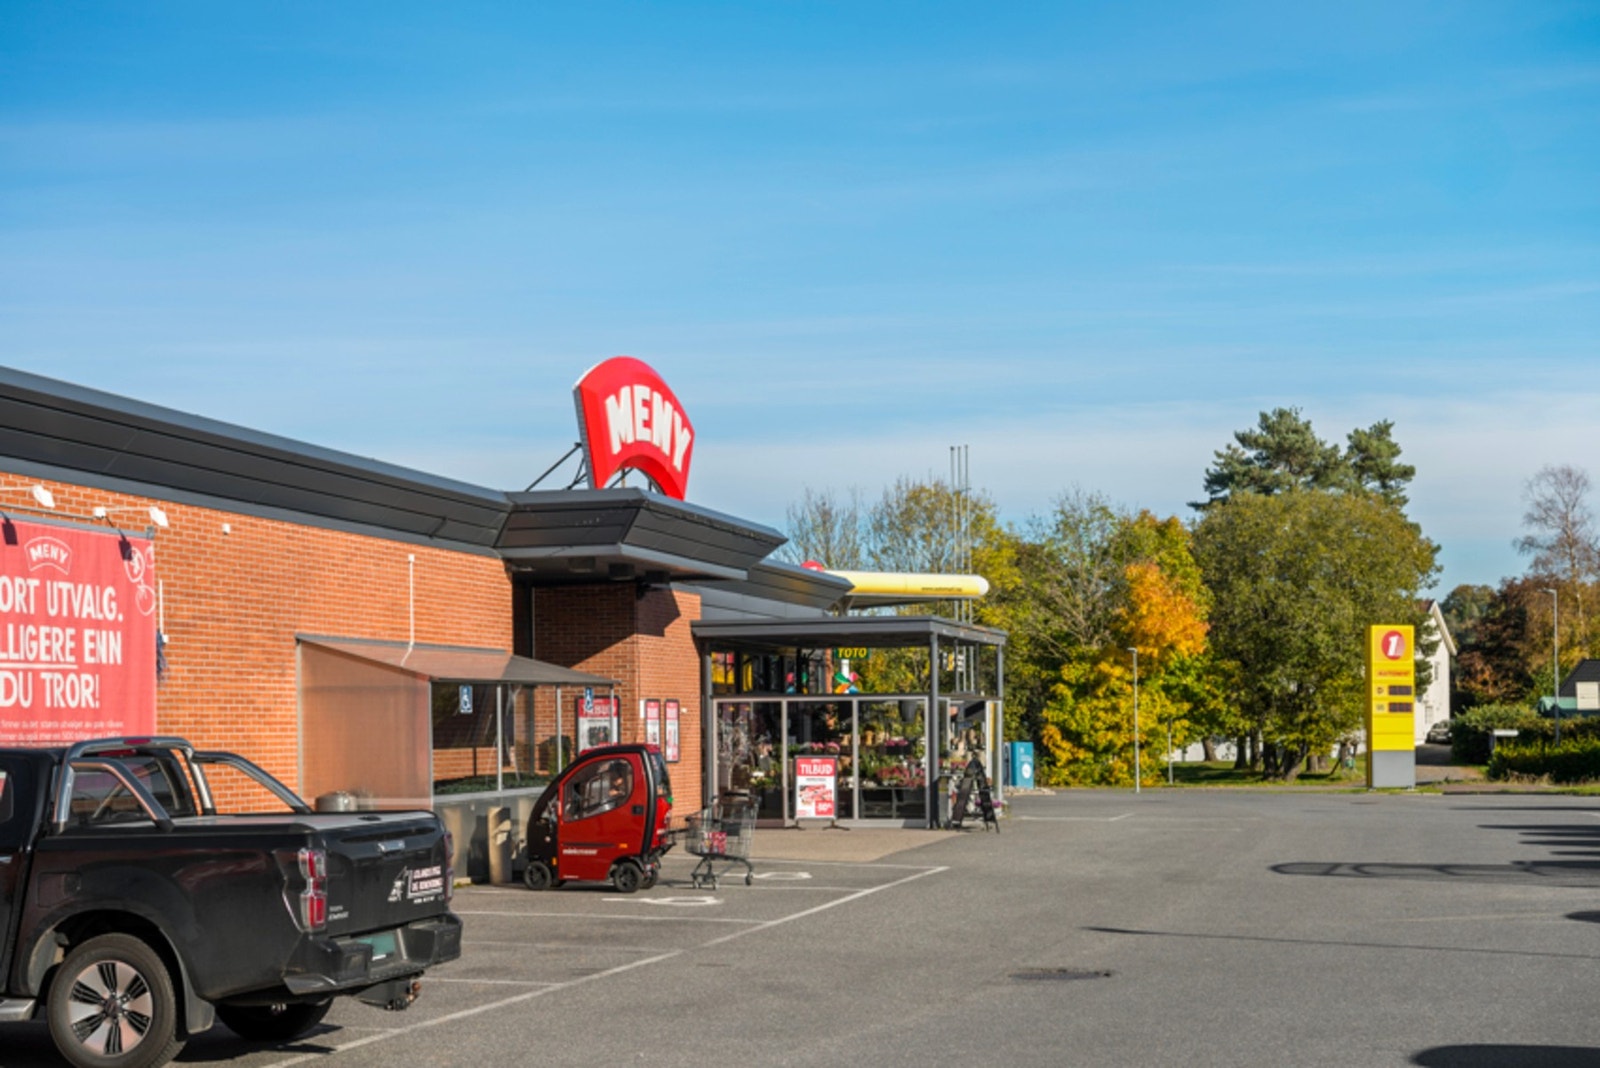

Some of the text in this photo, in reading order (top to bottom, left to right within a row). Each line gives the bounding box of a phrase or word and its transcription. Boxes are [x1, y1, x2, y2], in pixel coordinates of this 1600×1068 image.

[605, 384, 692, 473] MENY
[30, 543, 68, 563] MENY
[46, 580, 124, 622] UTVALG.
[84, 629, 121, 664] ENN
[0, 670, 100, 709] DU TROR!
[800, 764, 833, 775] TILBUD
